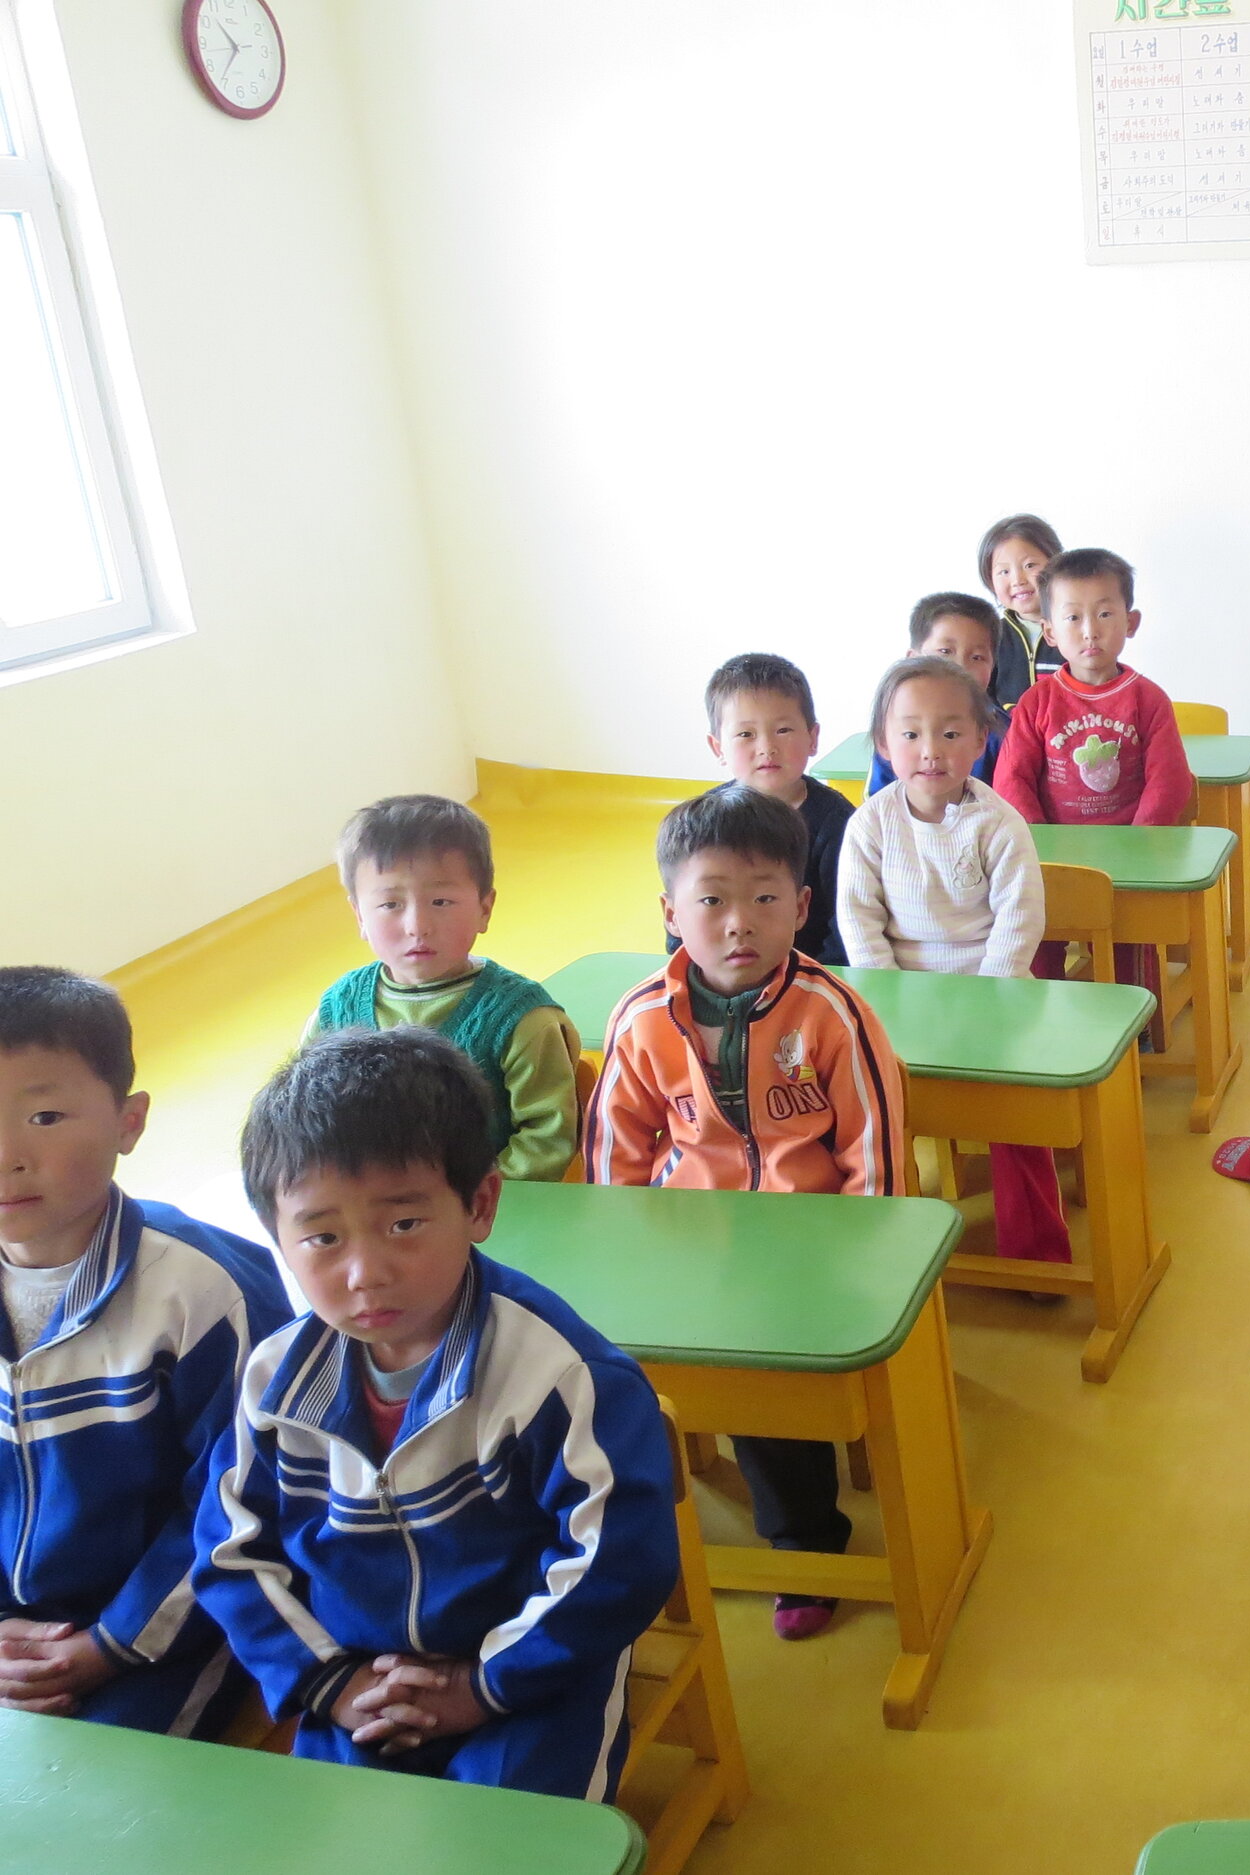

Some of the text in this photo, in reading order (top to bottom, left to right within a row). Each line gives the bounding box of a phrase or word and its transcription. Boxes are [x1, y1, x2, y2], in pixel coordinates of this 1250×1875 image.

[254, 23, 263, 36] 2
[199, 36, 206, 49] 9
[261, 45, 268, 58] 3
[206, 59, 214, 72] 8
[259, 69, 265, 79] 4
[221, 77, 228, 90] 7
[250, 82, 258, 94] 5
[236, 86, 244, 98] 6
[1099, 175, 1109, 190] 금
[1100, 200, 1111, 215] 토
[766, 1083, 828, 1120] ON
